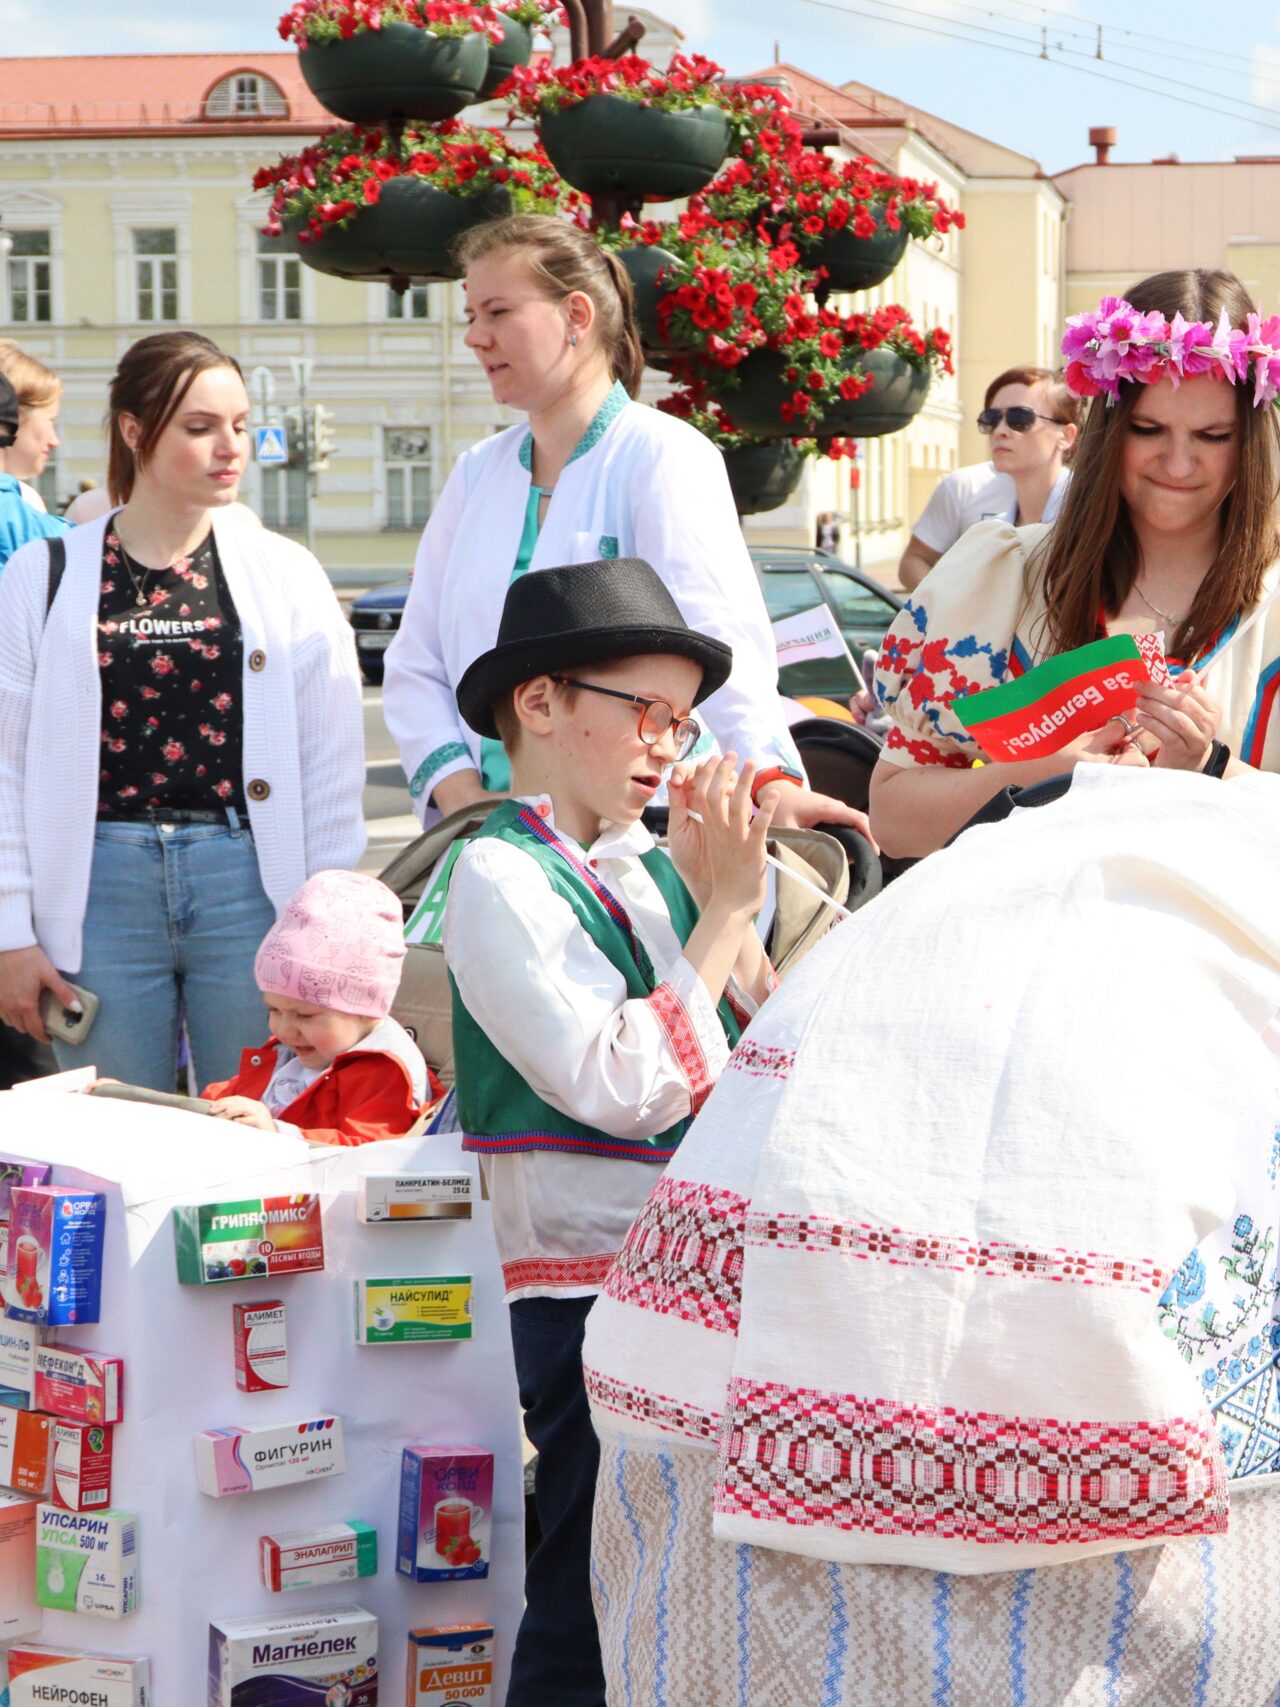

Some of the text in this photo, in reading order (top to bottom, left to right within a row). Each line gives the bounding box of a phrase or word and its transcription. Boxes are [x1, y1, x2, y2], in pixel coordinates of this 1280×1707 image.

[120, 618, 204, 635] FLOWERS
[1003, 672, 1136, 755] За Беларусь!
[395, 1178, 470, 1188] ПАНКРЕАТИН-БЕЛМЕД
[260, 1244, 270, 1253] 10
[270, 1250, 321, 1264] ЛЕСНЫЕ ЯГОДЫ
[246, 1310, 283, 1322] АЛИМЕТ
[254, 1438, 332, 1462] ФИГУРИН
[42, 1511, 108, 1534] УПСАРИН
[42, 1528, 77, 1547] УПСА
[80, 1535, 95, 1550] 500
[97, 1540, 108, 1551] мг
[294, 1542, 353, 1560] ЭНАЛАПРИЛ
[95, 1574, 106, 1582] 16
[252, 1636, 357, 1664] Магнелек
[32, 1684, 108, 1707] НЕЙРОФЕН
[358, 1696, 368, 1704] 30
